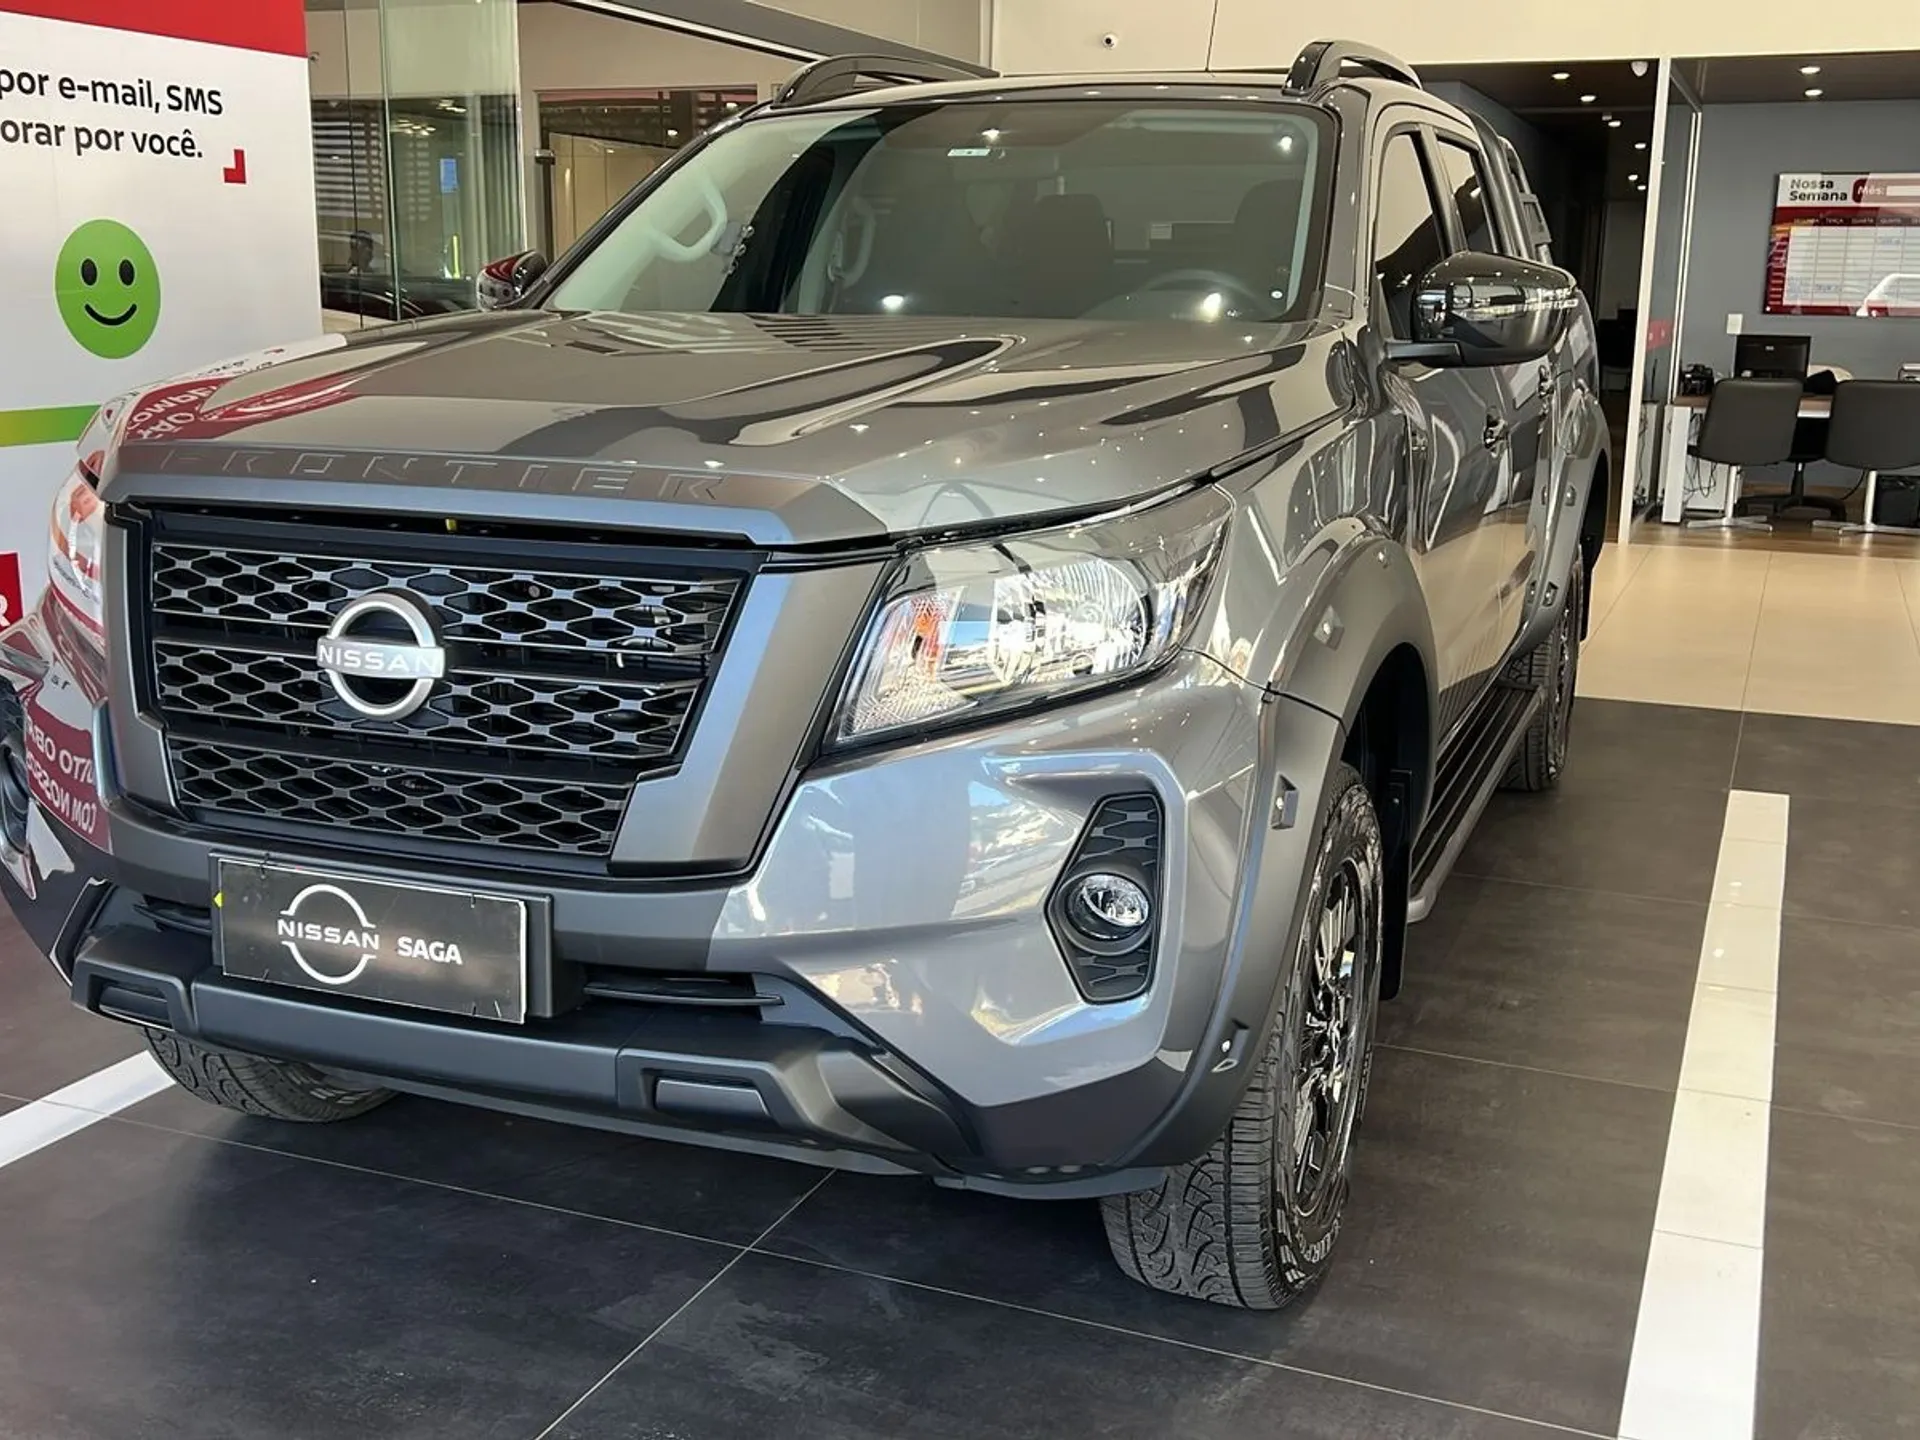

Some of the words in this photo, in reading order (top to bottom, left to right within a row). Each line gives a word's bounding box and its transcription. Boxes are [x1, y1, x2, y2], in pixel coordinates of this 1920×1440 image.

[0, 69, 49, 99] por
[58, 76, 160, 113] e-mail,
[166, 84, 223, 115] SMS
[0, 119, 65, 146] orar
[74, 125, 124, 156] por
[131, 129, 203, 157] você.
[1789, 191, 1848, 201] Semana
[1790, 179, 1834, 189] Nossa
[160, 449, 724, 500] FRONTIER
[319, 645, 440, 674] NISSAN
[277, 918, 380, 950] NISSAN
[397, 935, 463, 965] SAGA
